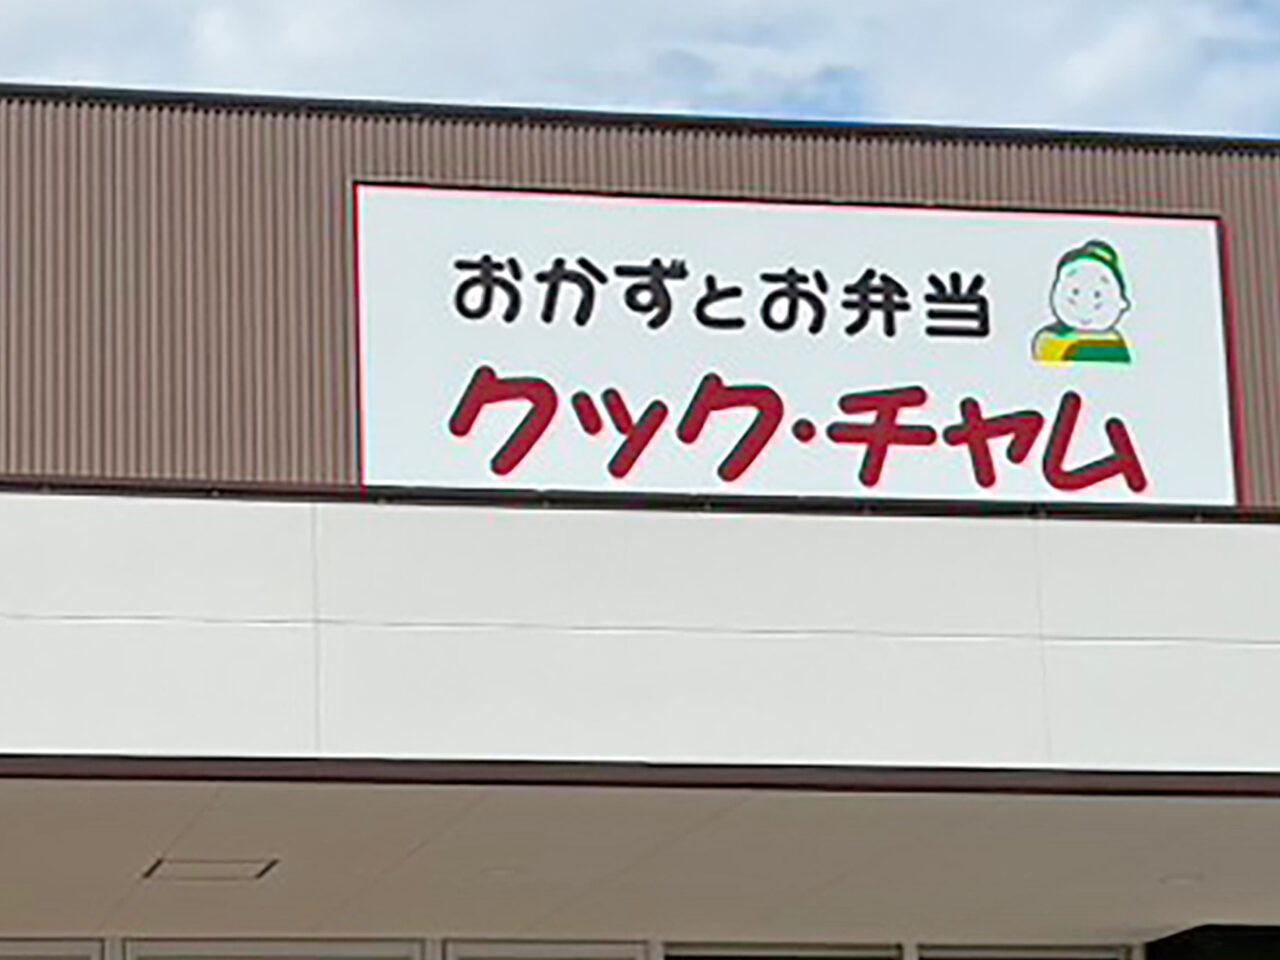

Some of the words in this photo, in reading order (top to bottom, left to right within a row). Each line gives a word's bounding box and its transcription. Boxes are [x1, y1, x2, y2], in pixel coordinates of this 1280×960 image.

[453, 253, 990, 338] おかずとお弁当
[448, 364, 1148, 493] クック・チャム
